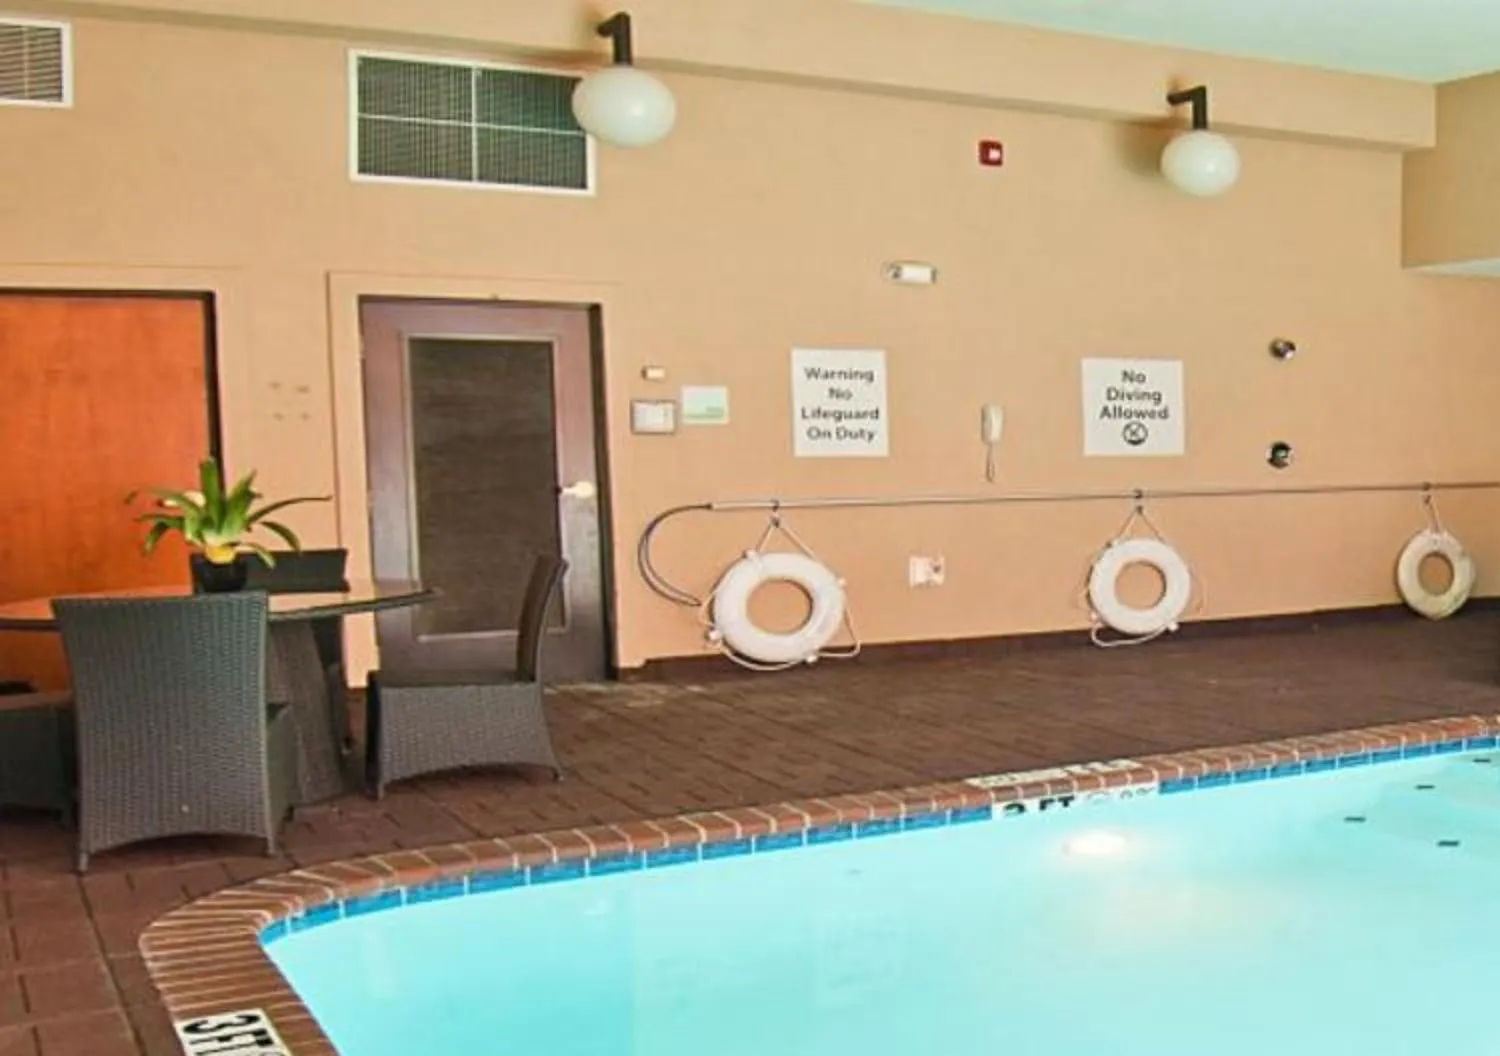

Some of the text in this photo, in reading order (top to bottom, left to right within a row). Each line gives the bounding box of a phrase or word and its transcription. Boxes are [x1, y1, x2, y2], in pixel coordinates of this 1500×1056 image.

[803, 367, 875, 384] Warning
[1121, 369, 1147, 384] No
[828, 387, 853, 401] No
[1106, 386, 1162, 406] Diving
[801, 406, 879, 422] Lifeguard
[1099, 404, 1169, 420] Allowed
[806, 426, 875, 444] On Duty
